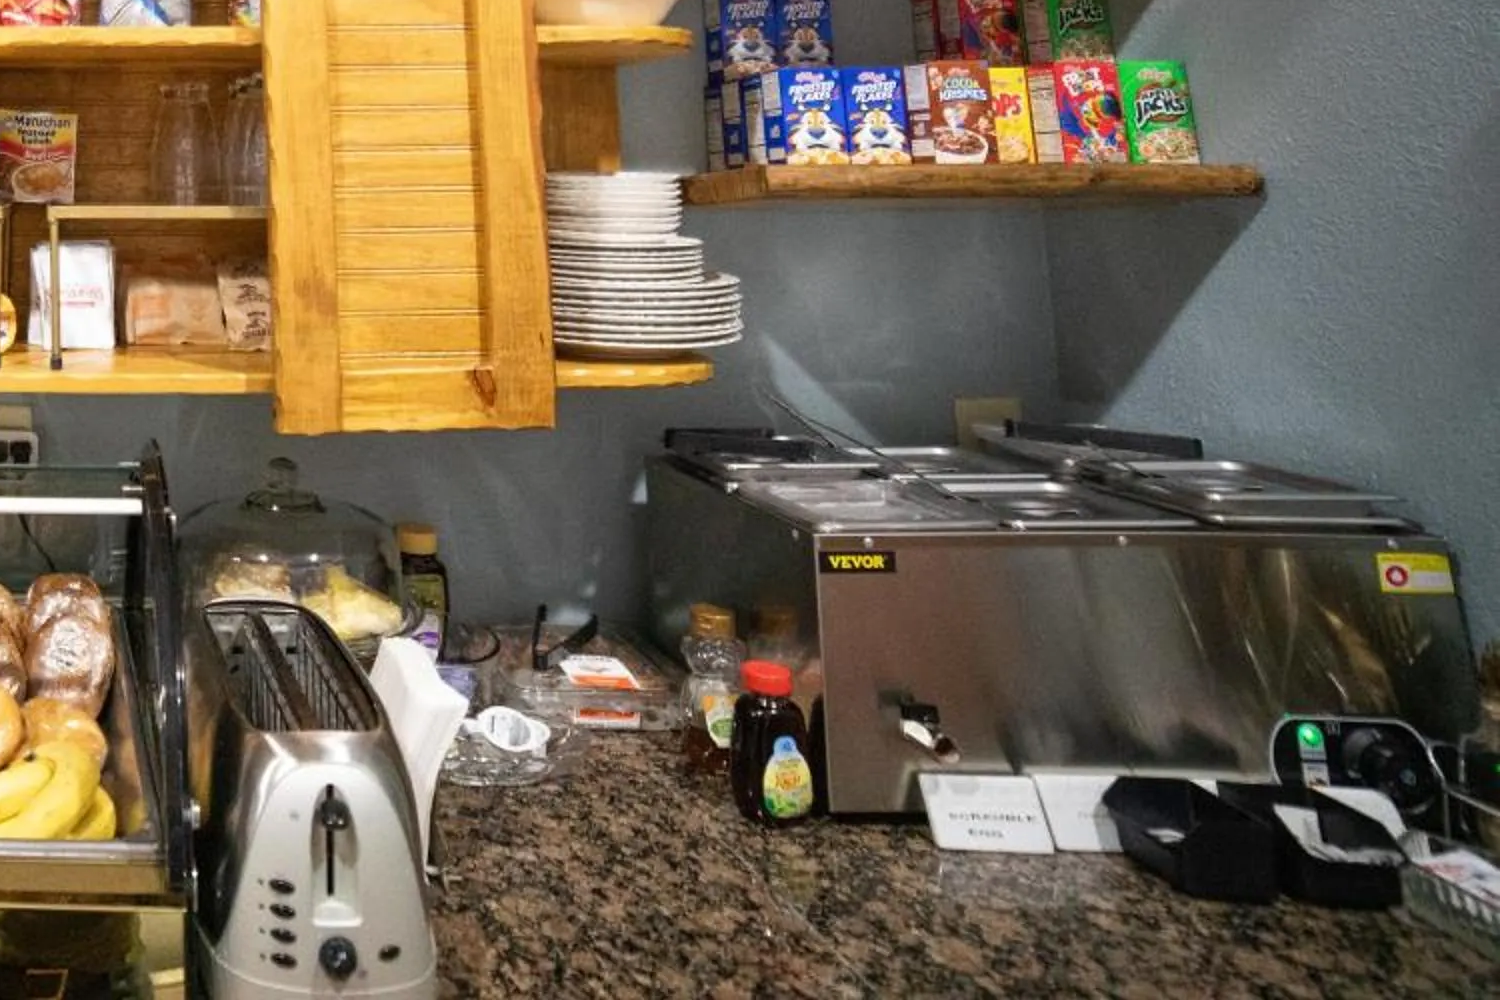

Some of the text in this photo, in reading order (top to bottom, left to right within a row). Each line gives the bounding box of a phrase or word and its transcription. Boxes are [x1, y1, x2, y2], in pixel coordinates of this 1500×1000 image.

[1135, 97, 1189, 129] JACKS
[14, 116, 71, 129] Maruchan
[828, 554, 885, 569] VEVOR
